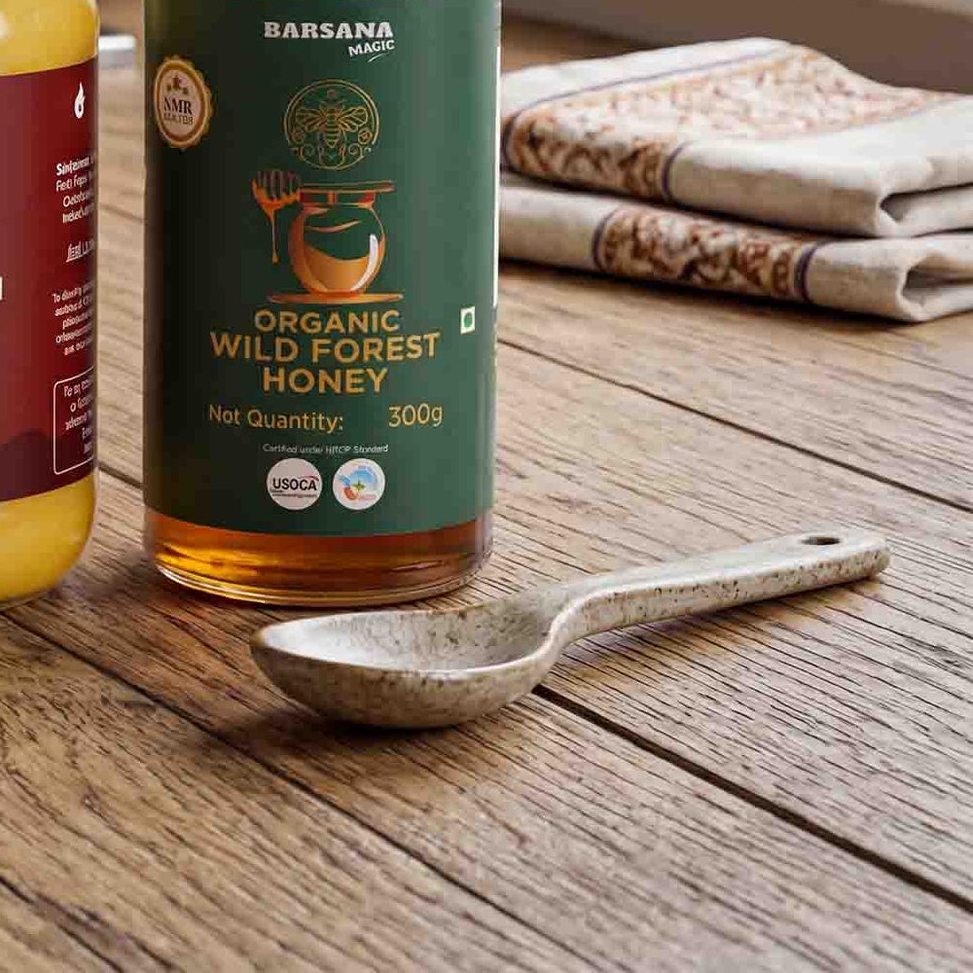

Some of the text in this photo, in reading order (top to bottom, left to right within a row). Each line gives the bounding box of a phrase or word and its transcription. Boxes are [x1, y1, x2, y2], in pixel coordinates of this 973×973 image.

[263, 21, 394, 39] BARSANA
[348, 39, 396, 57] MAGIC
[254, 309, 401, 334] ORGANIC
[209, 332, 441, 363] WILD FOREST
[262, 367, 389, 395] HONEY
[247, 409, 343, 434] Quantity:
[388, 403, 443, 428] 300g
[272, 477, 317, 491] USOCA
